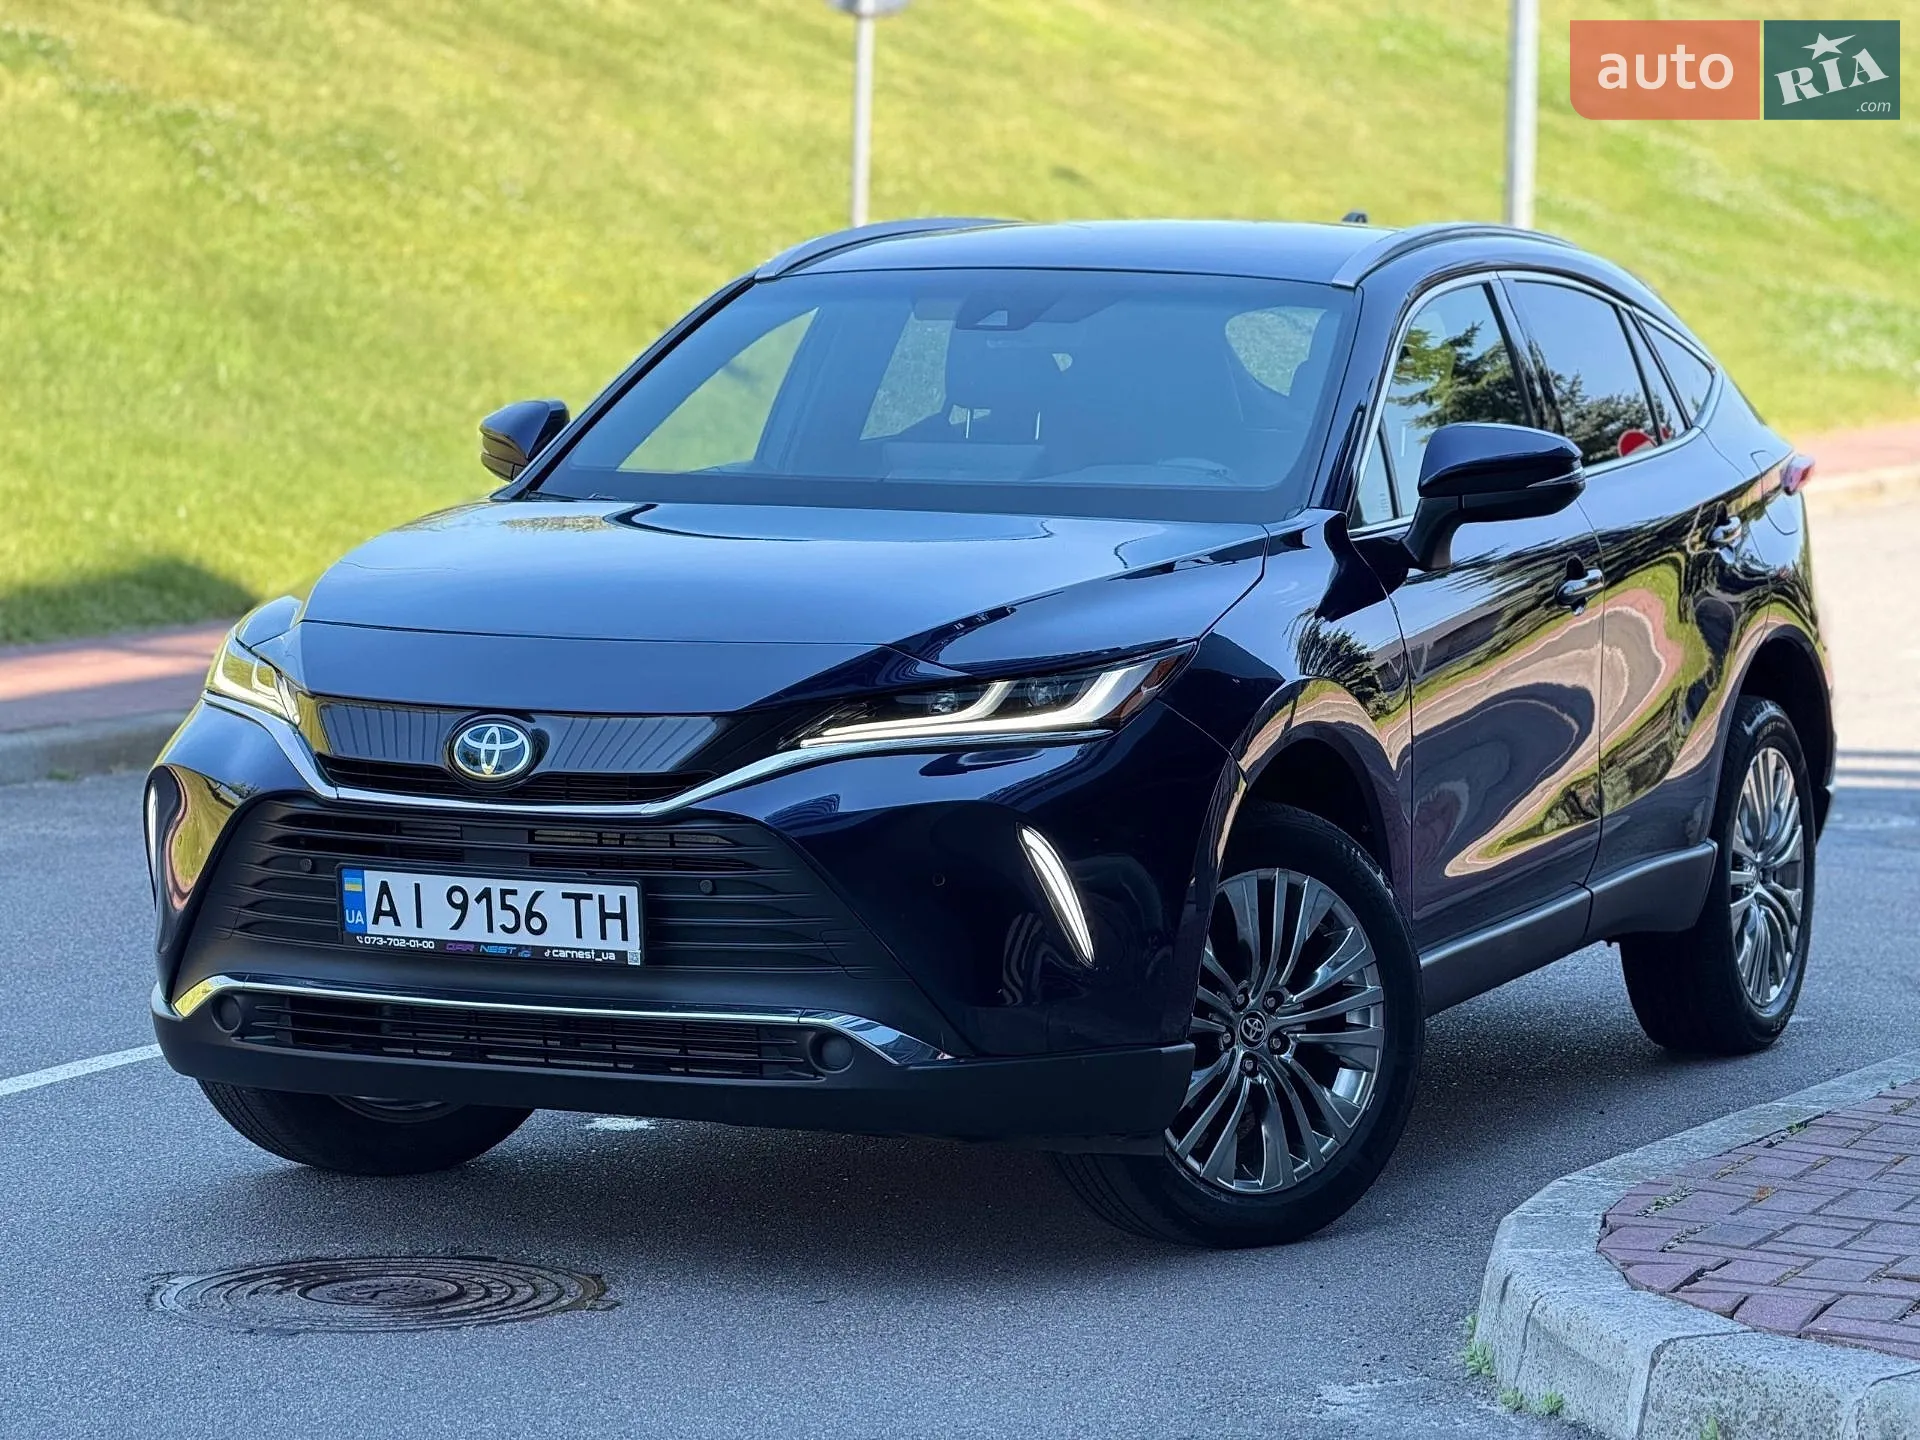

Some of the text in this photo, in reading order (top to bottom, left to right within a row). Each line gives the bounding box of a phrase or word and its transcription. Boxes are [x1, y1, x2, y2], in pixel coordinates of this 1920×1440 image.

[345, 909, 364, 925] UA
[372, 880, 629, 941] AI 9156 TH
[364, 936, 435, 949] 073-702-01-00
[552, 949, 616, 961] carnest_ua
